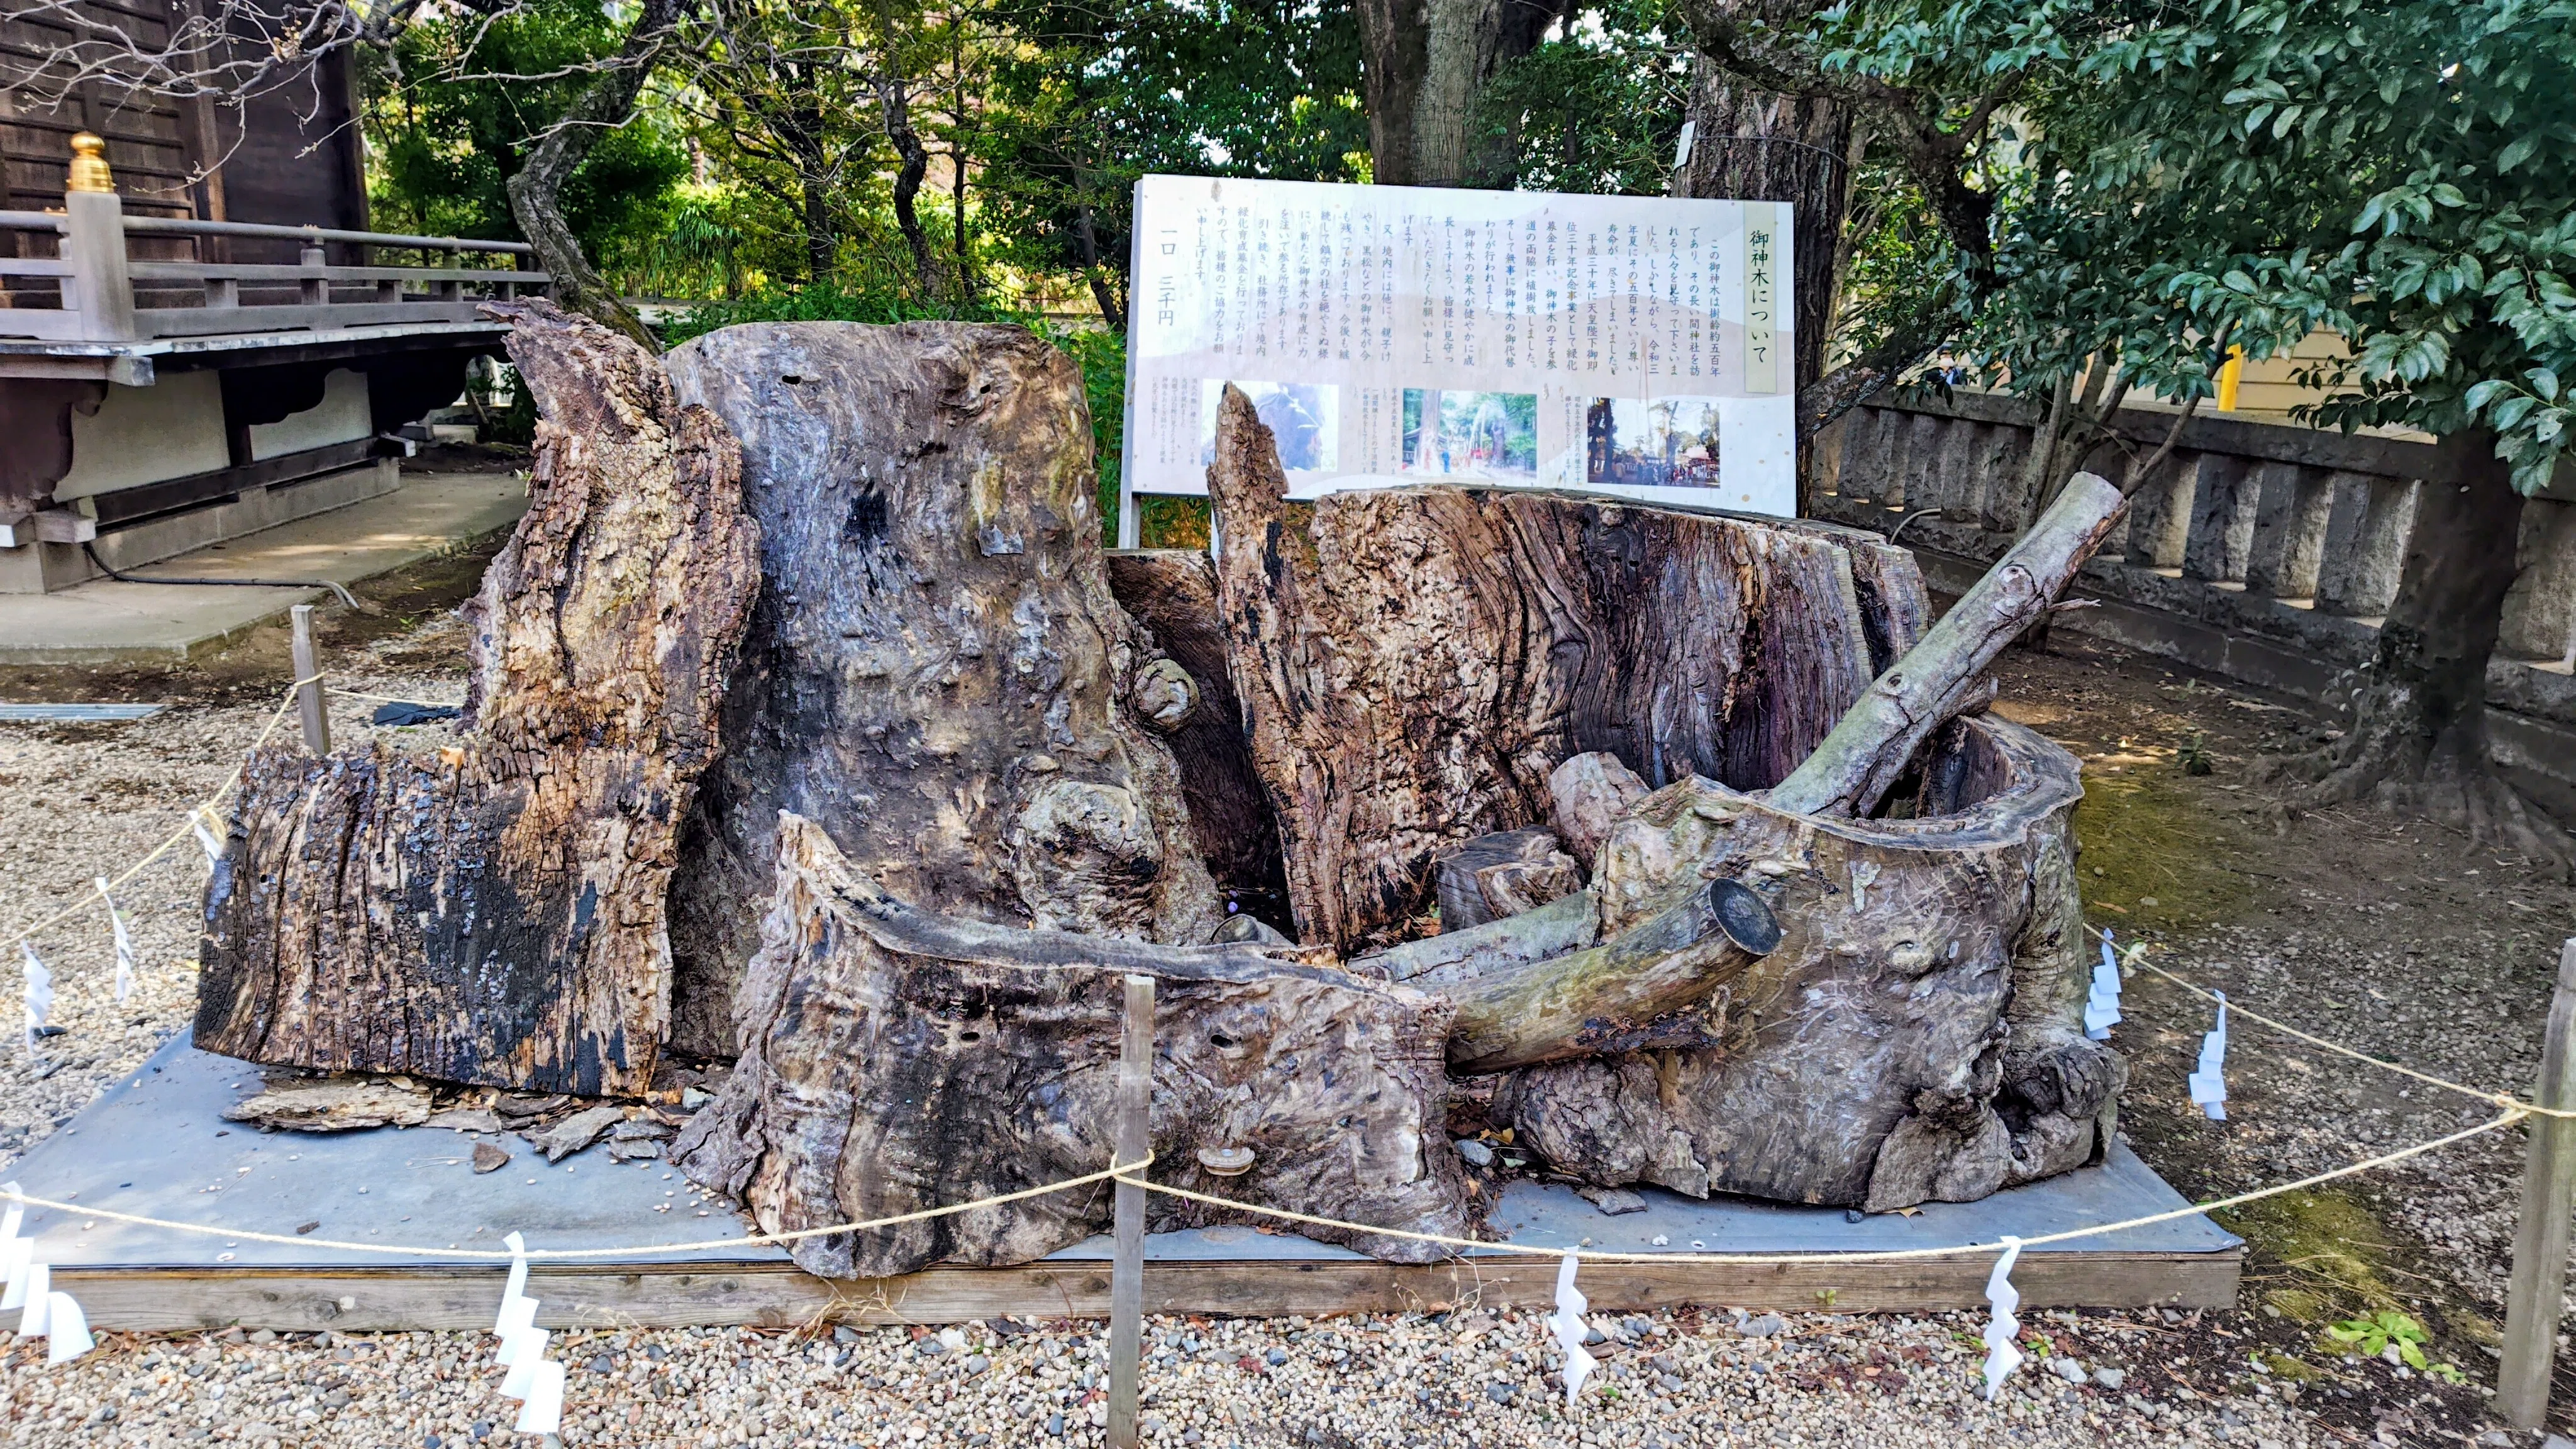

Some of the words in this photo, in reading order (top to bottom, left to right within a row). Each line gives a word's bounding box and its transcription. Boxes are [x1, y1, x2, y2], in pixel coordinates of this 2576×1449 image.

[1158, 275, 1175, 326] 三千円
[1160, 229, 1178, 255] 一口
[1195, 207, 1208, 286] い申し上げます。
[1213, 206, 1228, 354] すので、皆様のご協力をお願
[1235, 207, 1248, 355] 緑化育成募金を行っておりま
[1255, 218, 1269, 356] 引き続き、社務所にて境内
[1277, 208, 1290, 355] を注いで参る所存であります。
[1297, 210, 1311, 358] に、新たな御神木の育成に力
[1318, 210, 1331, 360] 続して鎮守の杜を絶やさぬ様
[1338, 211, 1352, 360] も残っております。今後も継
[1360, 213, 1373, 362] やき、黒松などの御神木が今
[1380, 224, 1393, 362] 又、境内には他に、親子け
[1403, 214, 1414, 252] げます。
[1423, 216, 1433, 364] ていただきたくお願い申し上
[1443, 216, 1455, 362] 長しますよう、皆様に見守っ
[1463, 228, 1475, 366] 御神木の若木が健やかに成
[1485, 218, 1496, 321] わりが行われました。
[1505, 219, 1516, 368] そして無事に御神木の御代替
[1526, 221, 1537, 369] 道の両脇に植樹致しました。
[1546, 221, 1557, 369] 募金を行い、御神木の子を参
[1566, 221, 1578, 371] 位三十年記念事業として緑化
[1587, 234, 1598, 372] 平成三十年に天皇陛下御即
[1628, 225, 1639, 372] 年夏にその五百年という尊い
[1648, 226, 1660, 374] した。しかしながら、令和三
[1668, 227, 1680, 375] れる人々を見守って下さいま
[1689, 227, 1700, 376] であり、その長い間神社を訪
[1749, 230, 1769, 363] 御神木について
[1708, 240, 1721, 377] この御神木は樹齢約五百年
